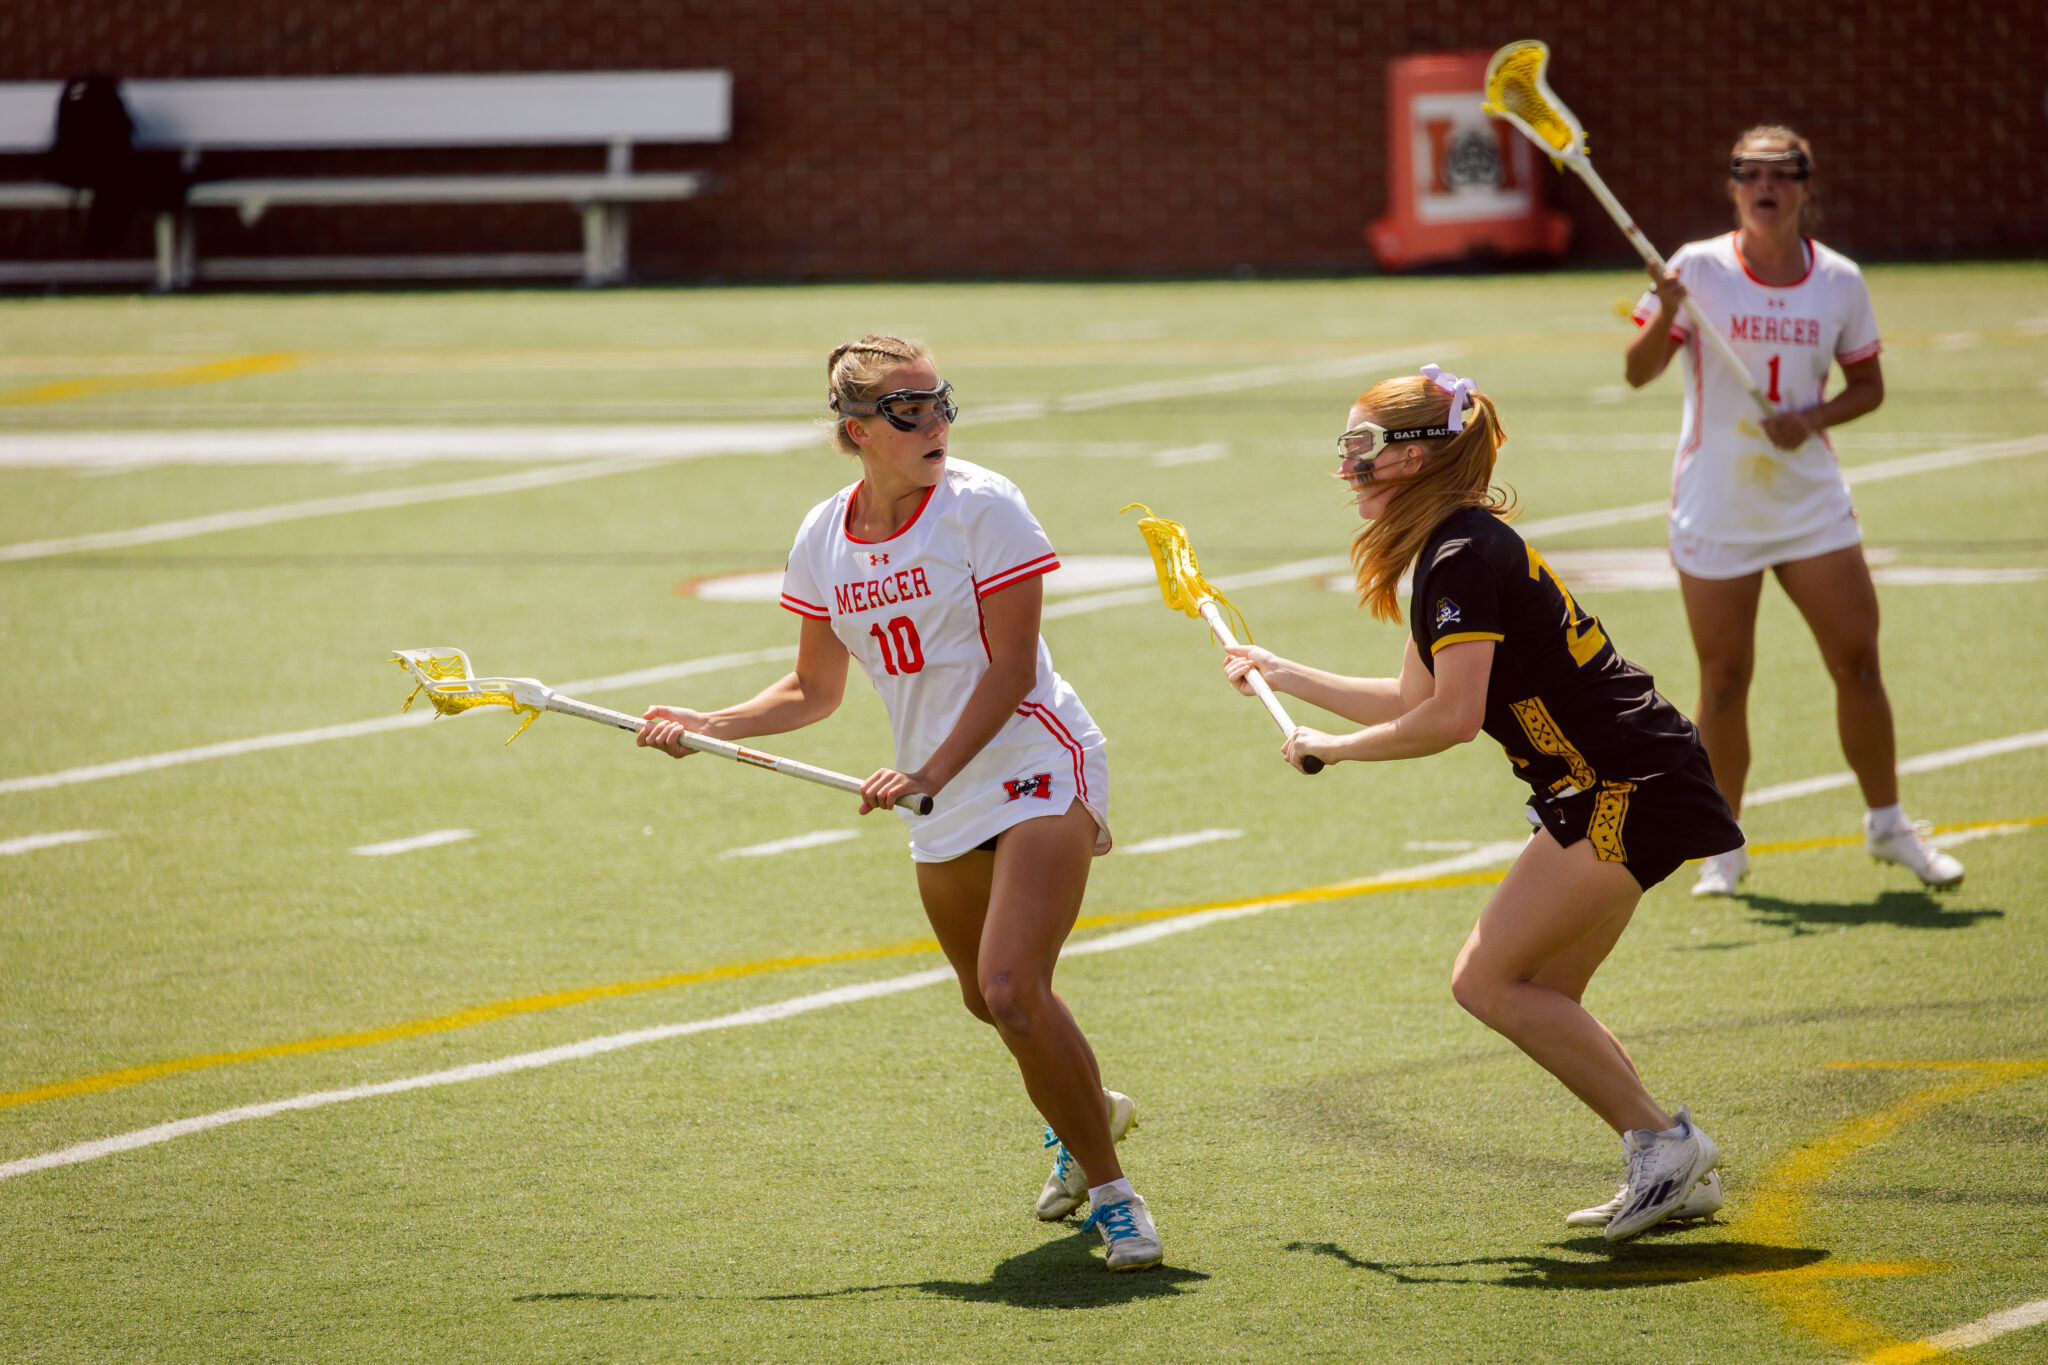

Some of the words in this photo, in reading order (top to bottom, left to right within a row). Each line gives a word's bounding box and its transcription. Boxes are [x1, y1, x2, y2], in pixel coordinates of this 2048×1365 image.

[1731, 315, 1820, 347] MERCER
[1768, 356, 1780, 402] 1
[1394, 430, 1422, 440] GAIT
[834, 566, 932, 615] MERCER
[869, 616, 925, 675] 10
